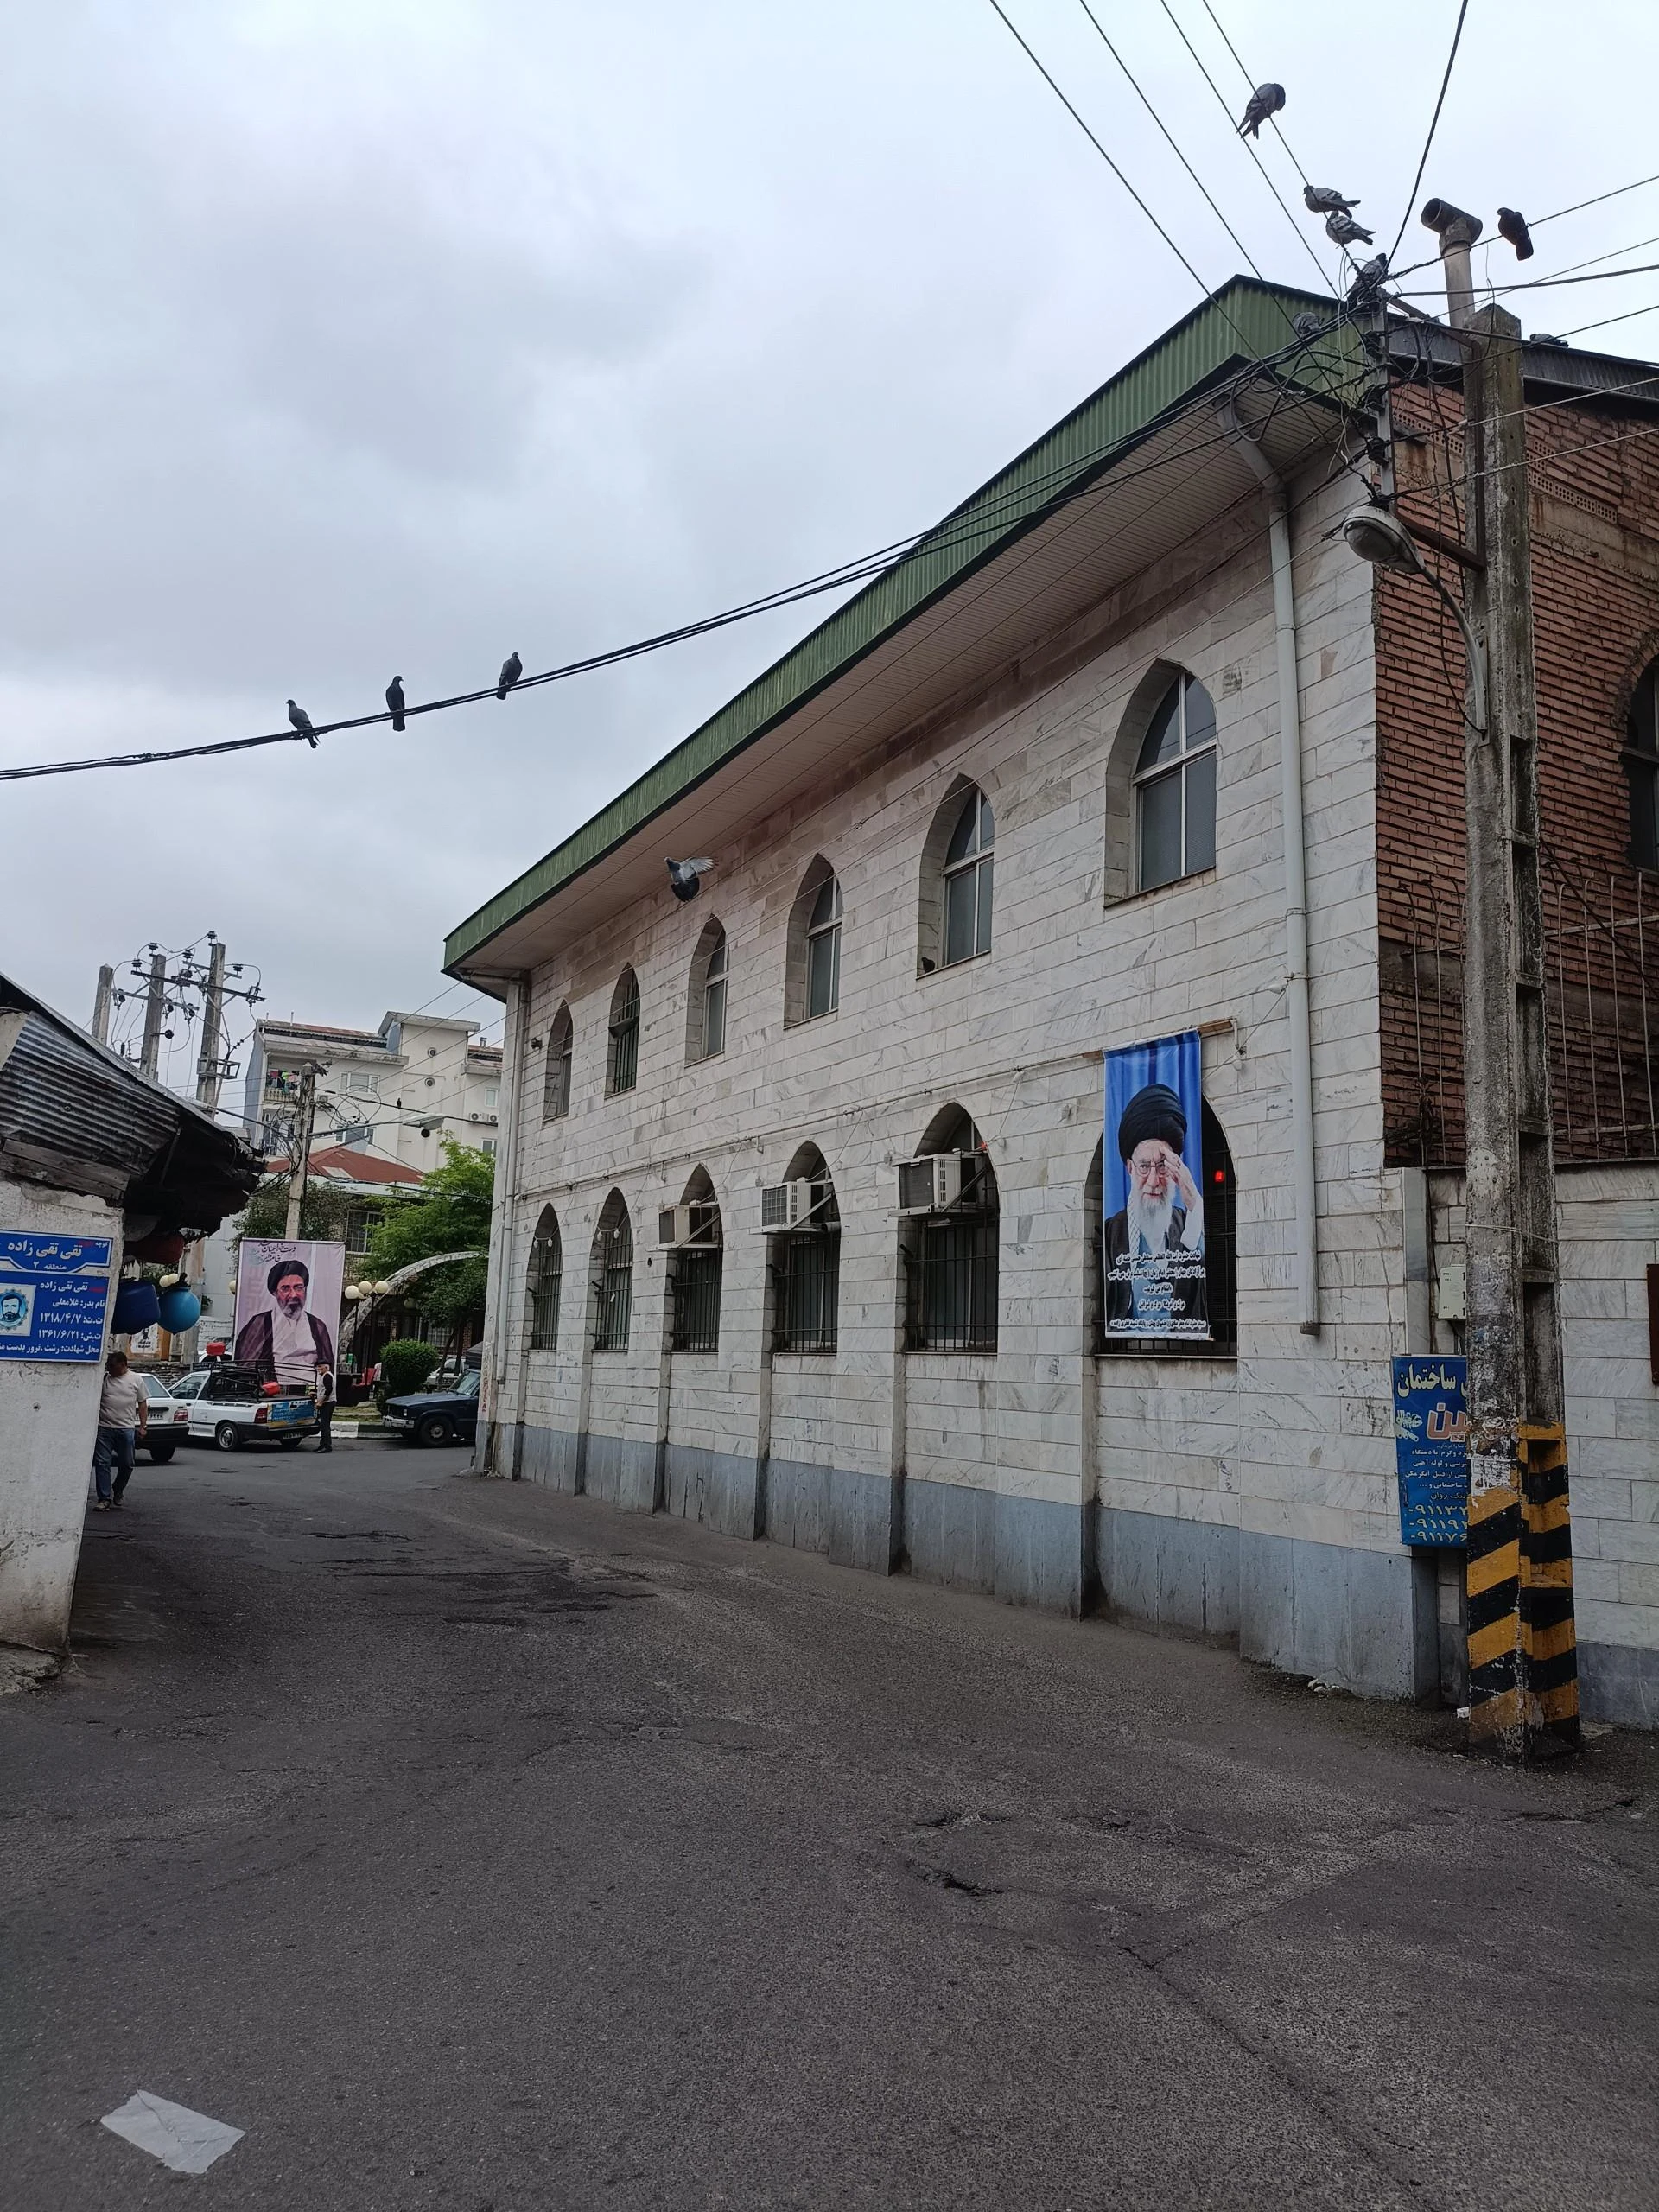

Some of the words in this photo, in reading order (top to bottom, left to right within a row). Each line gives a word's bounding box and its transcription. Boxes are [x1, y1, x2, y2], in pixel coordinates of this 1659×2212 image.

[8, 1239, 33, 1256] زاده
[36, 1243, 59, 1257] تقی
[60, 1245, 83, 1259] تقی
[33, 1261, 39, 1270] ۲
[40, 1281, 56, 1292] زاده
[58, 1281, 73, 1292] تقی
[73, 1282, 89, 1294] تقی
[52, 1297, 79, 1307] غلامعلی
[95, 1300, 105, 1309] نام
[6, 1343, 26, 1352] بدست
[44, 1344, 60, 1354] رشت
[85, 1345, 99, 1355] محل
[1397, 1363, 1456, 1397] ساختمان
